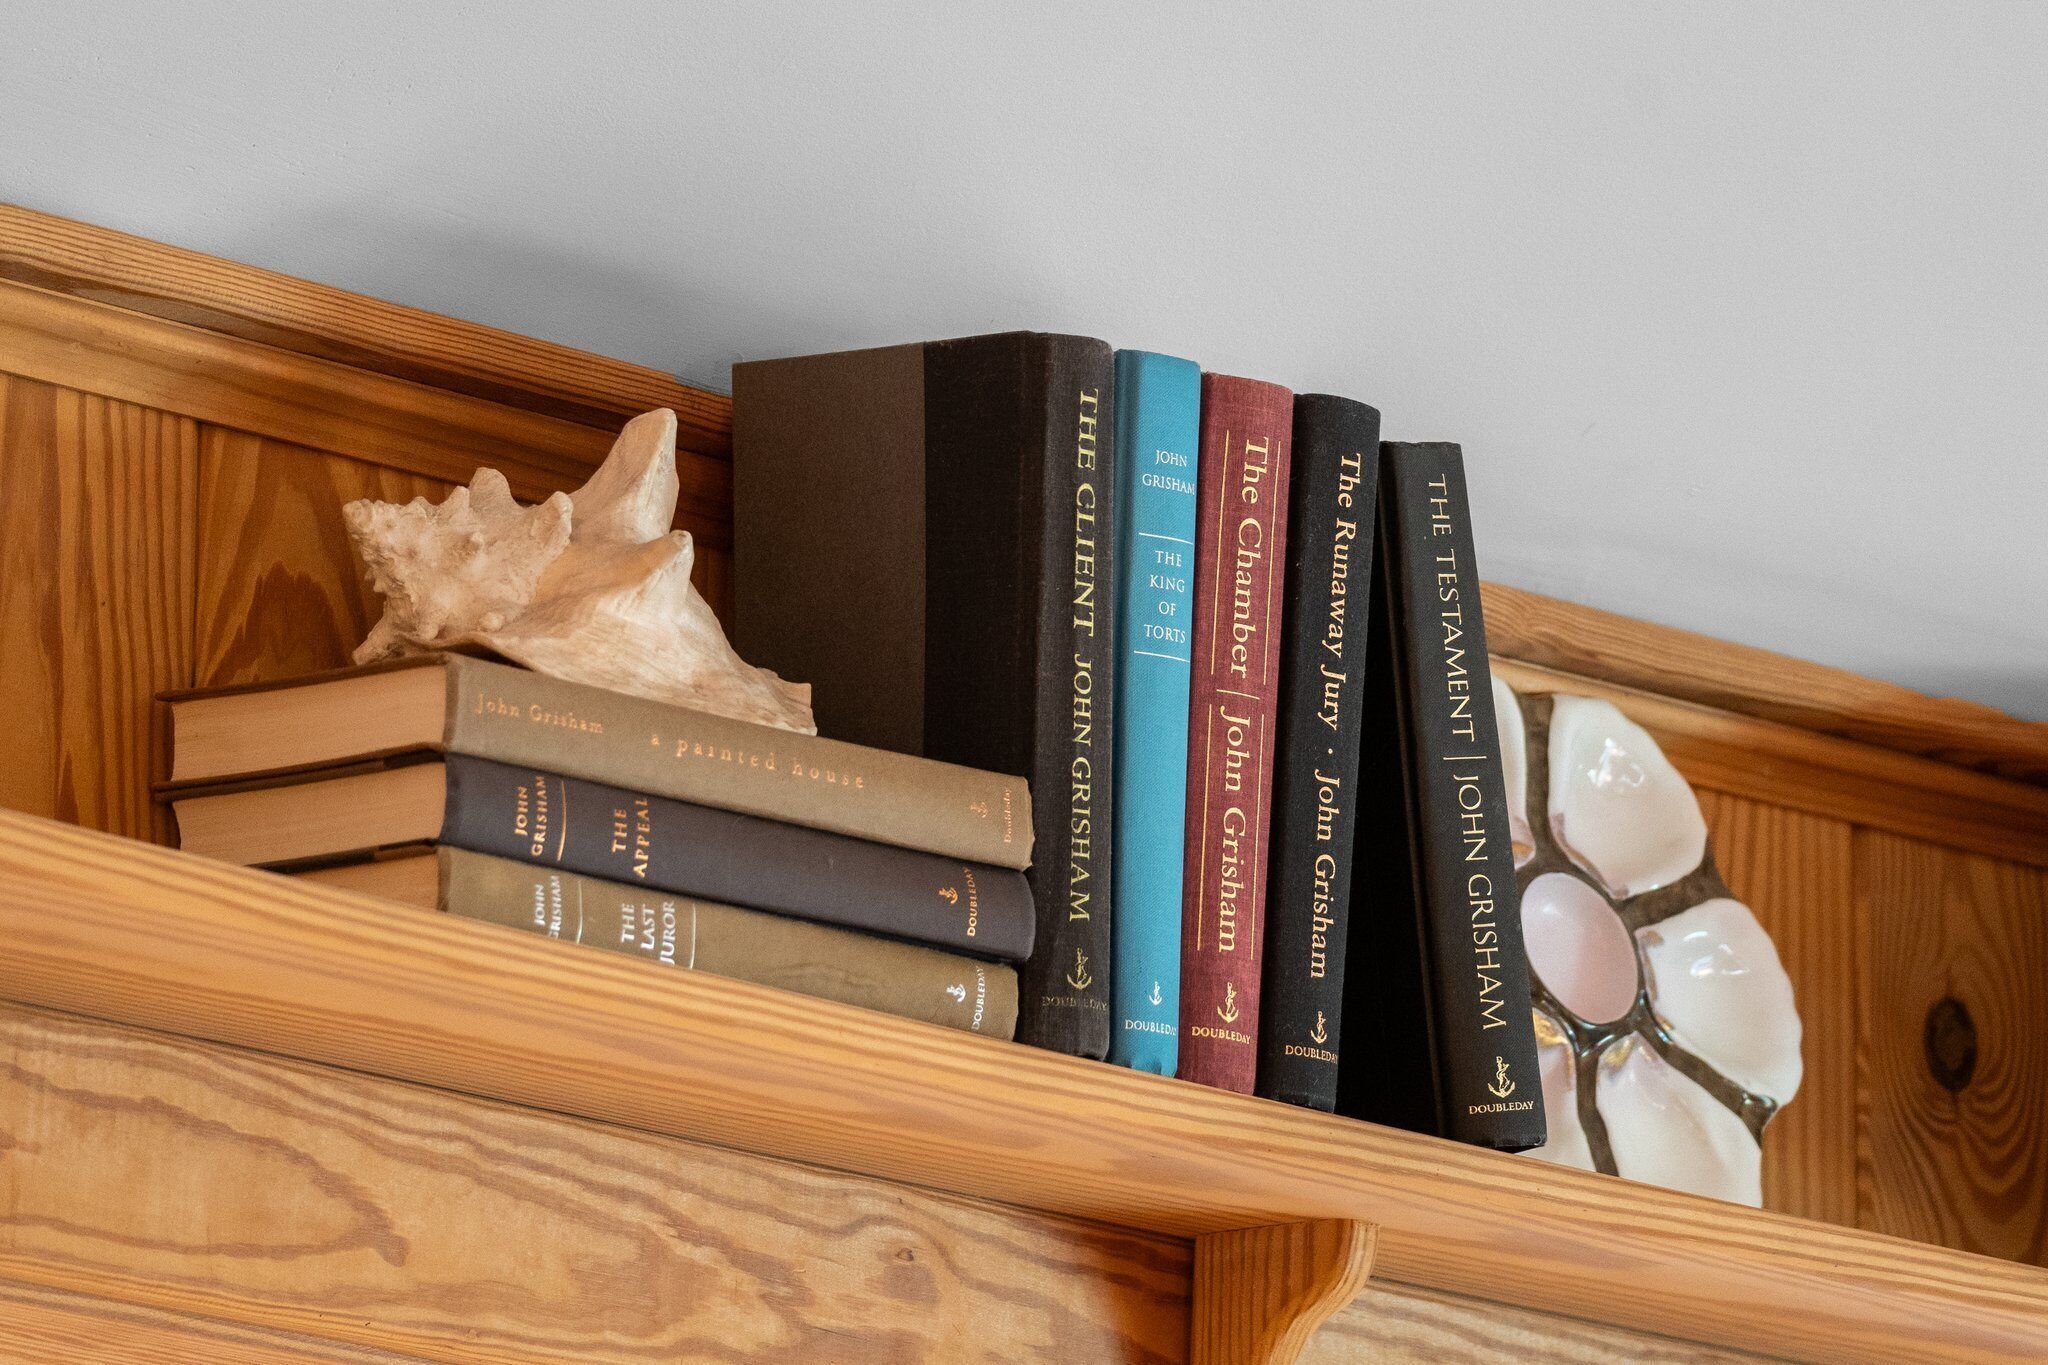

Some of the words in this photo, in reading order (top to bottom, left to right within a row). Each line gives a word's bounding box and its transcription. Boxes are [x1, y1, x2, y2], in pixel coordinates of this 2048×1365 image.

[1077, 388, 1099, 471] THE
[1155, 450, 1188, 467] JOHN
[1142, 473, 1195, 496] GRISHAM
[1241, 436, 1269, 504] The
[1337, 453, 1362, 508] The
[1428, 473, 1452, 537] THE
[1073, 482, 1096, 638] CLIENT
[1150, 574, 1185, 593] KING
[1155, 550, 1183, 567] THE
[1321, 517, 1357, 659] Runaway
[1158, 601, 1177, 617] OF
[1230, 517, 1262, 679] Chamber
[1143, 623, 1186, 644] TORTS
[1436, 548, 1475, 743] TESTAMENT
[474, 692, 520, 718] John
[528, 703, 603, 734] Grisham
[1072, 653, 1092, 747] JOHN
[1317, 664, 1347, 731] Jury
[651, 734, 661, 747] a
[675, 738, 777, 771] painted
[792, 757, 866, 789] house
[1220, 705, 1250, 792] John
[514, 786, 528, 837] JOHN
[531, 776, 548, 857] GRISHAM
[611, 808, 628, 854] THE
[1315, 768, 1341, 842] John
[1453, 773, 1489, 862] JOHN
[633, 798, 650, 879] APPEAL
[1069, 756, 1092, 922] GRISHAM
[534, 884, 546, 927] JOHN
[963, 867, 978, 937] DOUBLEDAY
[1218, 806, 1246, 953] Grisham
[621, 903, 635, 943] THE
[640, 903, 656, 950] LAST
[659, 900, 676, 966] JUROR
[1310, 854, 1337, 980] Grisham
[1468, 873, 1507, 1031] GRISHAM
[971, 966, 986, 1030] DOUBLEDAY
[1191, 1026, 1252, 1045] DOUBLEDAY
[1468, 1099, 1535, 1116] DOUBLEDAY
